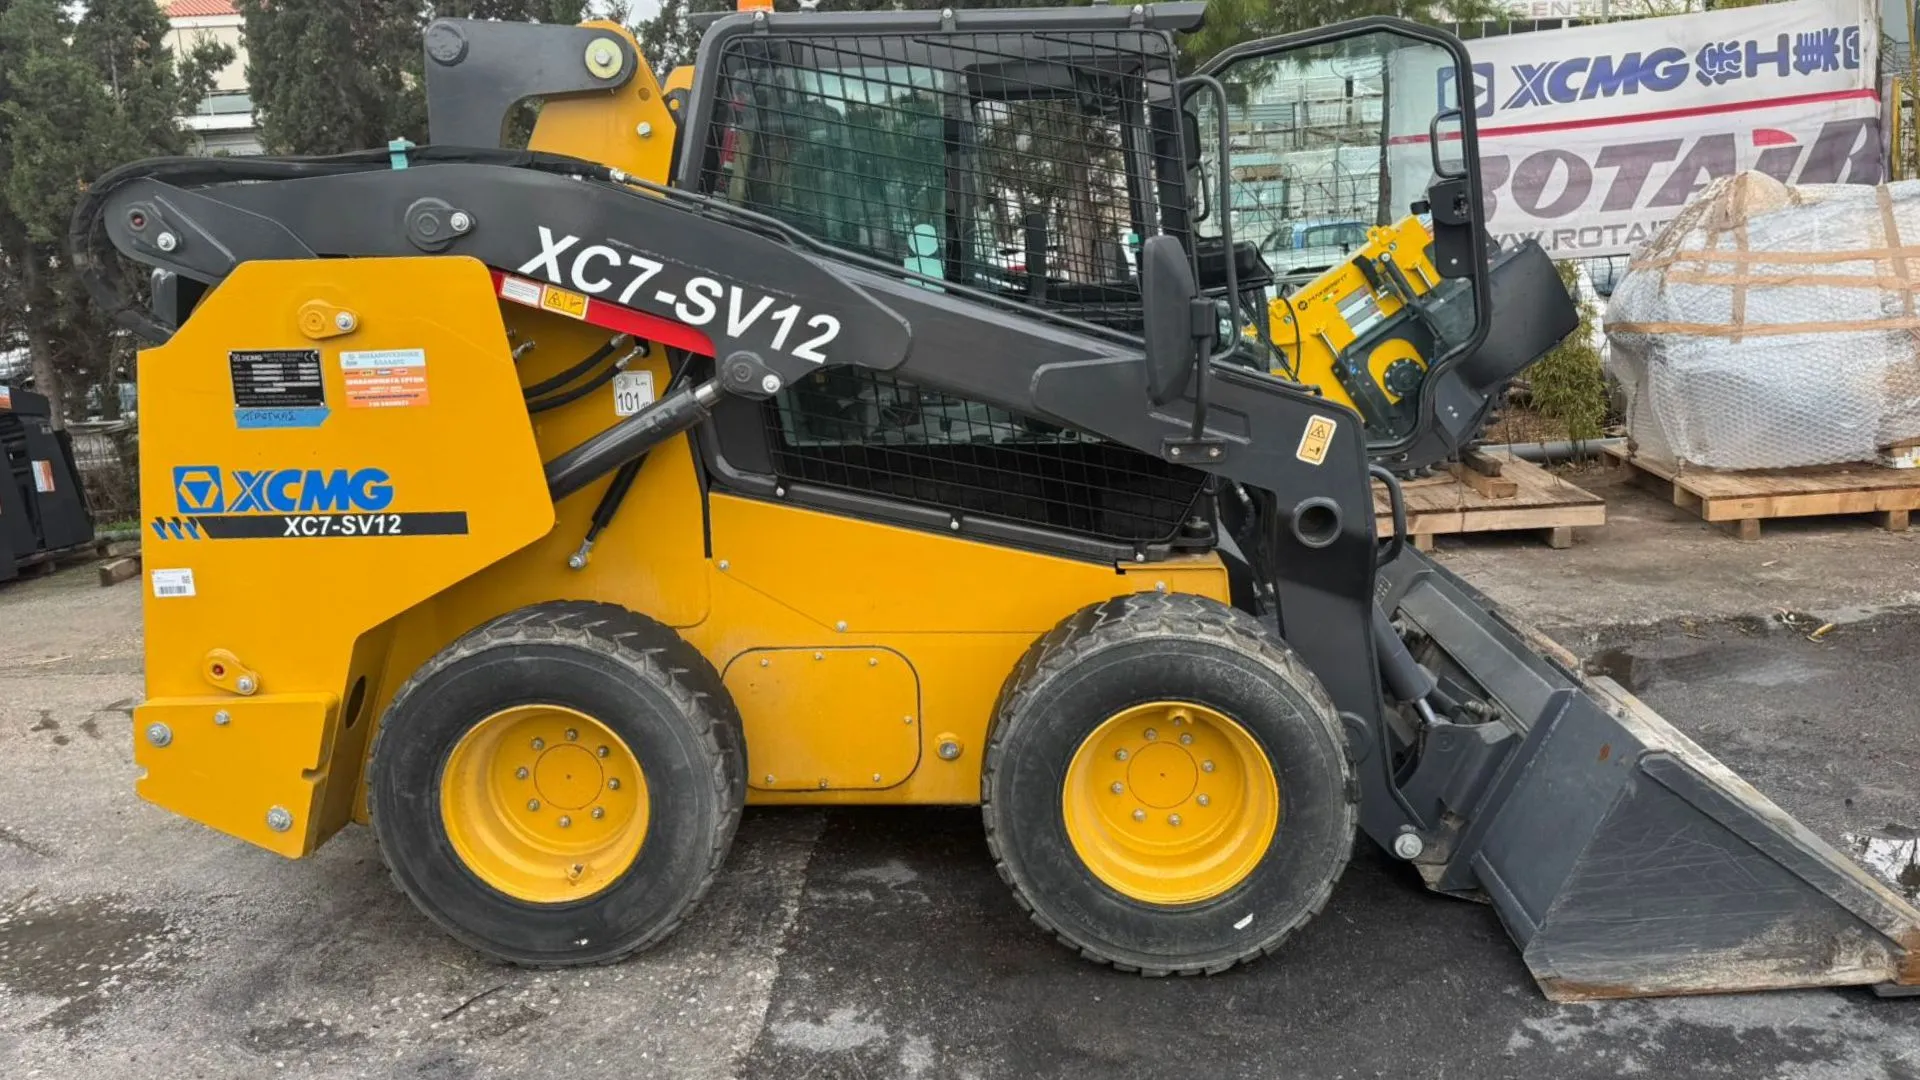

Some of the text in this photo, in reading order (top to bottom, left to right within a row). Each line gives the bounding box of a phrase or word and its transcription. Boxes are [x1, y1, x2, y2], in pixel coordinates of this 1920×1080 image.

[1500, 47, 1690, 110] XCMG
[517, 226, 841, 364] XC7-SV12
[618, 391, 639, 411] 101
[226, 468, 394, 512] XCMG
[284, 514, 401, 536] XC7-SV12
